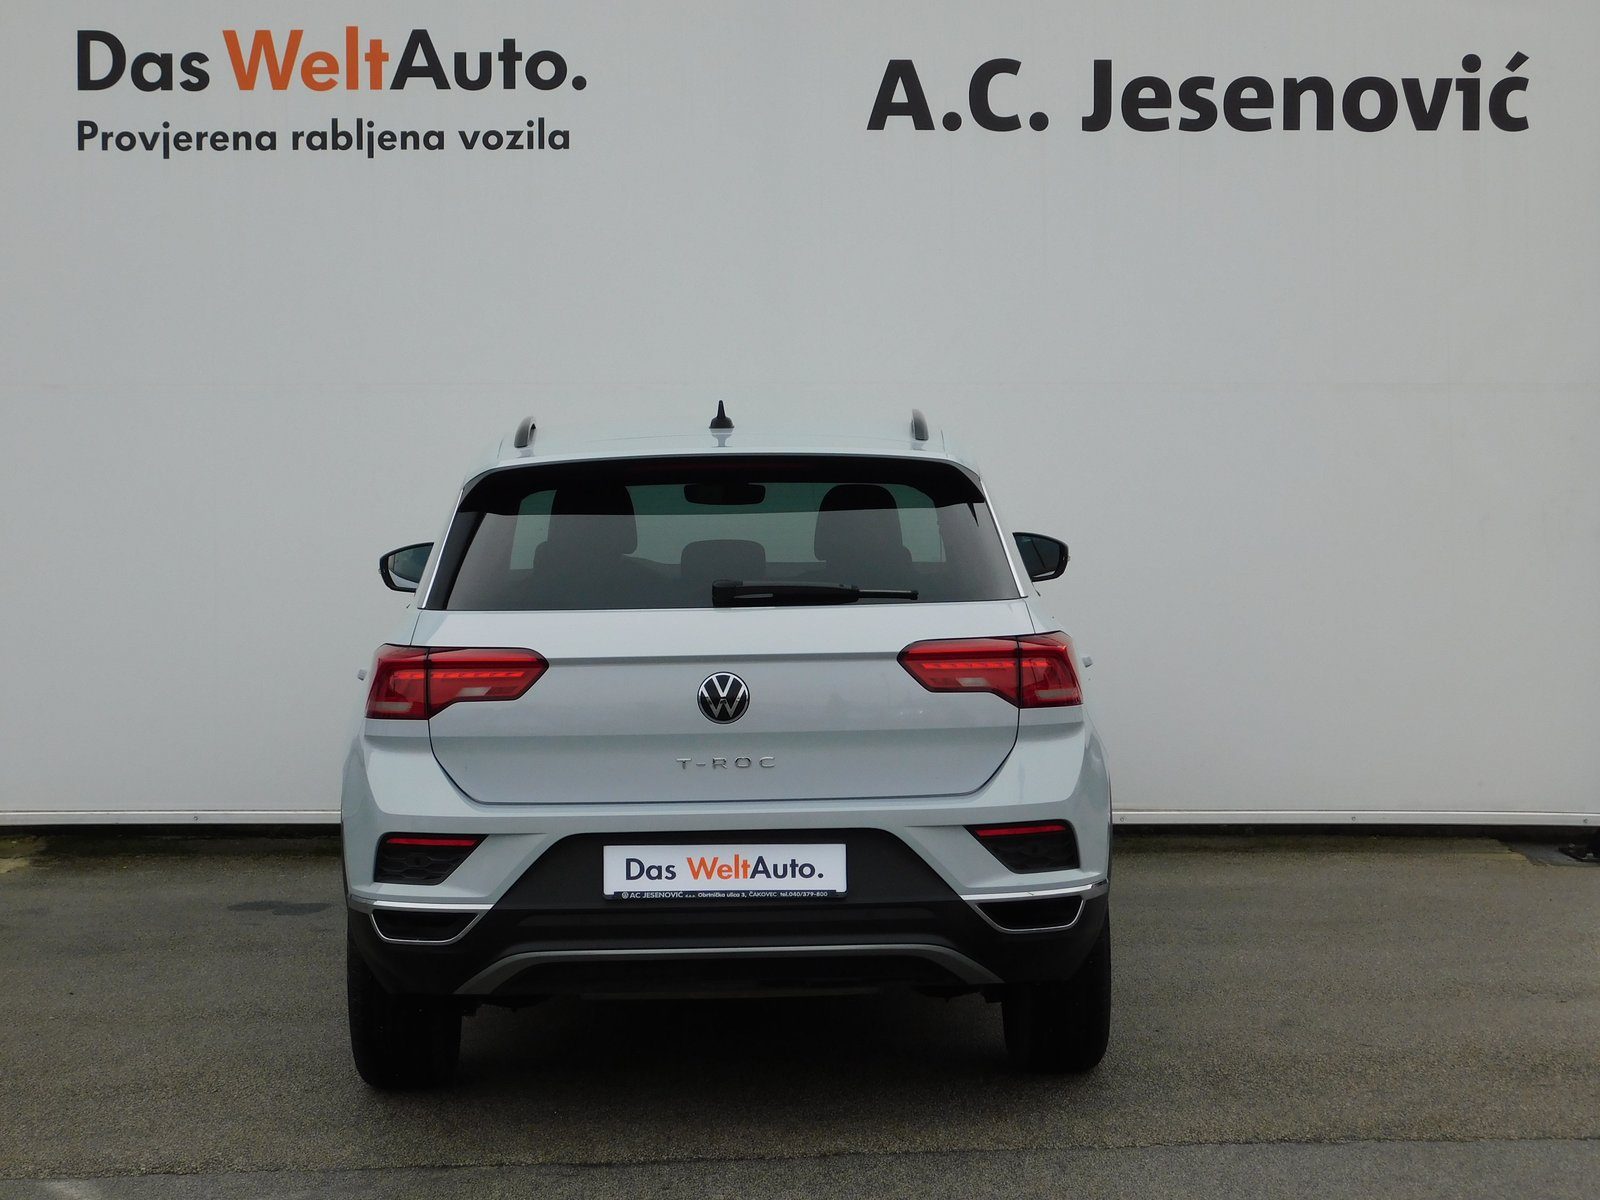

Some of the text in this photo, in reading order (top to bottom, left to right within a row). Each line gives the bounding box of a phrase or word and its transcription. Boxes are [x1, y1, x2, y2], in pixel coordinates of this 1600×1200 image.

[77, 26, 587, 92] Das WeltAuto.
[866, 51, 1530, 132] A.C. Jesenović
[77, 117, 570, 160] Provjerena rabljena vozila
[676, 756, 776, 770] T-ROC
[625, 854, 824, 881] Das WeltAuto.
[630, 891, 641, 899] AC
[642, 890, 684, 899] JESENOVIĆ
